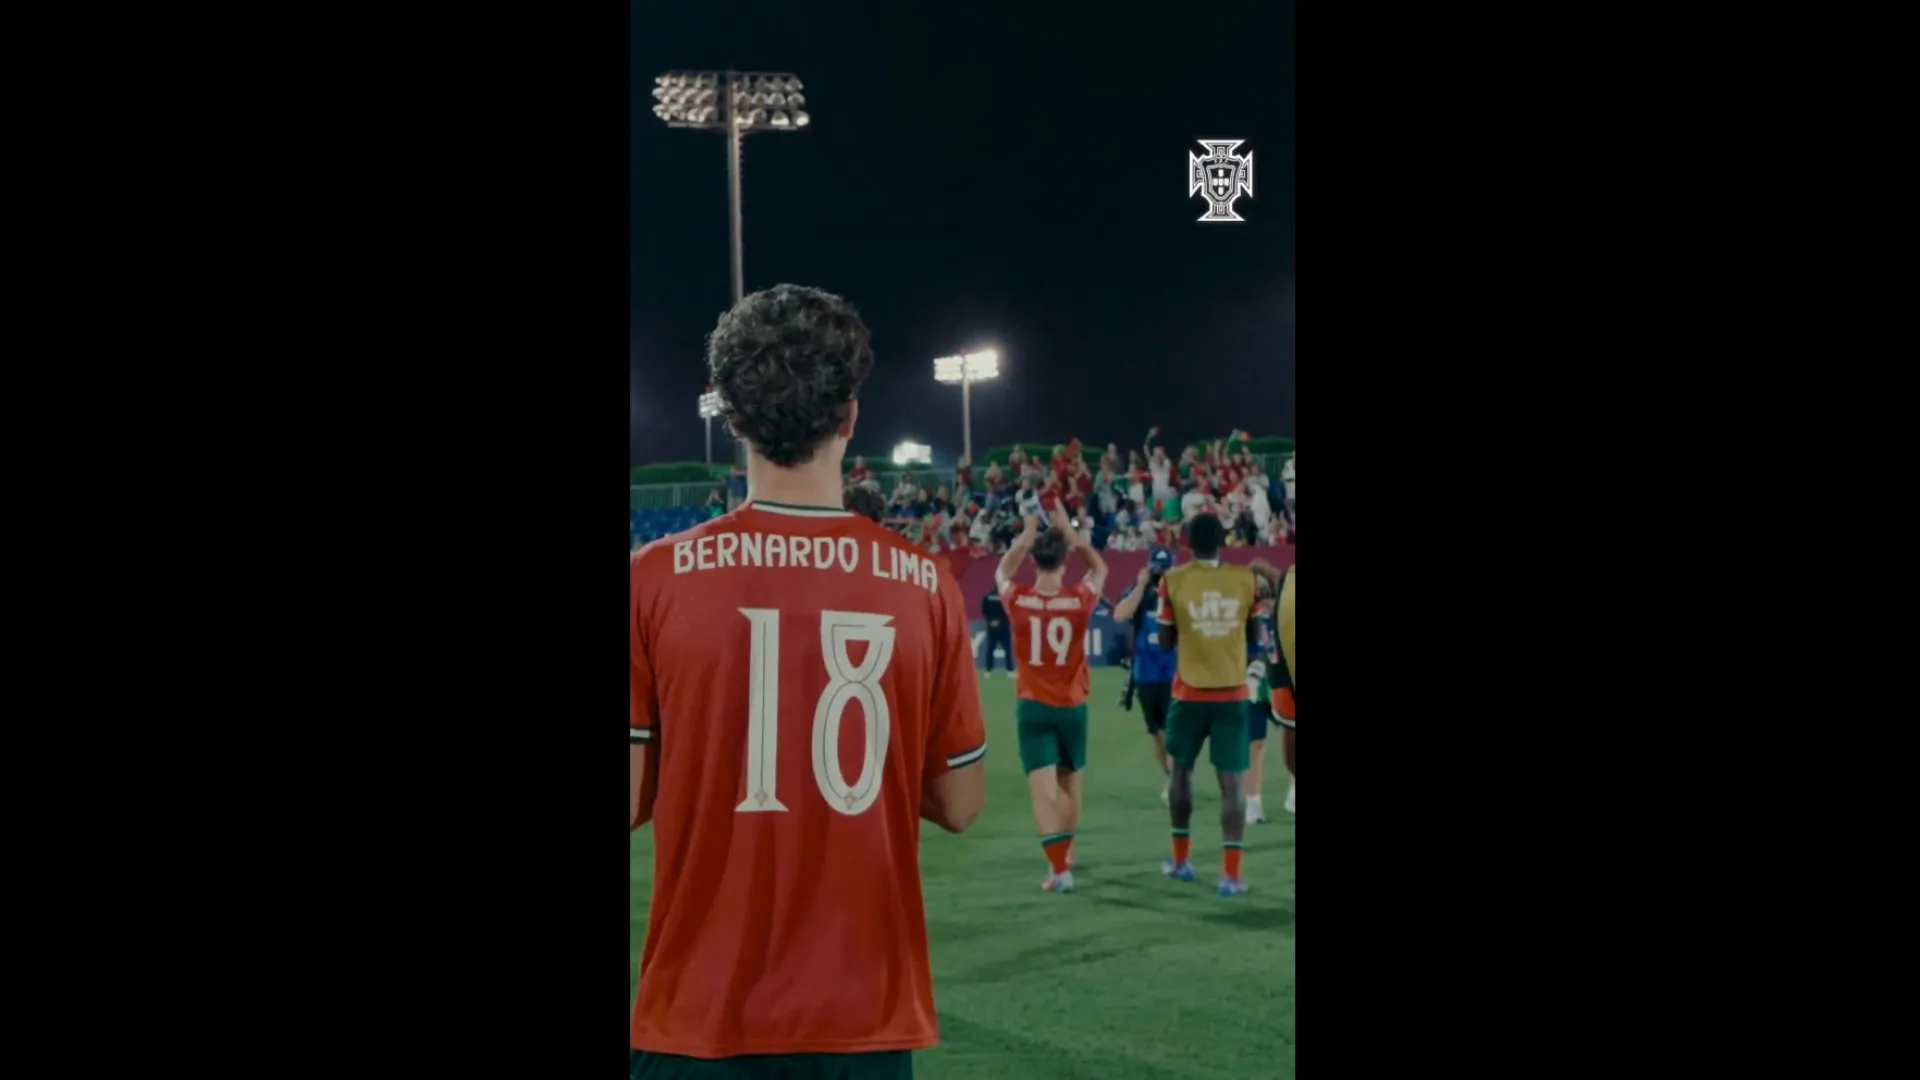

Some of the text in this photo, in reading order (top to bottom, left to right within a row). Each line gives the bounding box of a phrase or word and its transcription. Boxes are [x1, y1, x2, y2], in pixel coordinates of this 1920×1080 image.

[674, 532, 938, 593] BERNARDO LIMA
[1028, 616, 1073, 666] 19
[734, 607, 896, 815] 18
